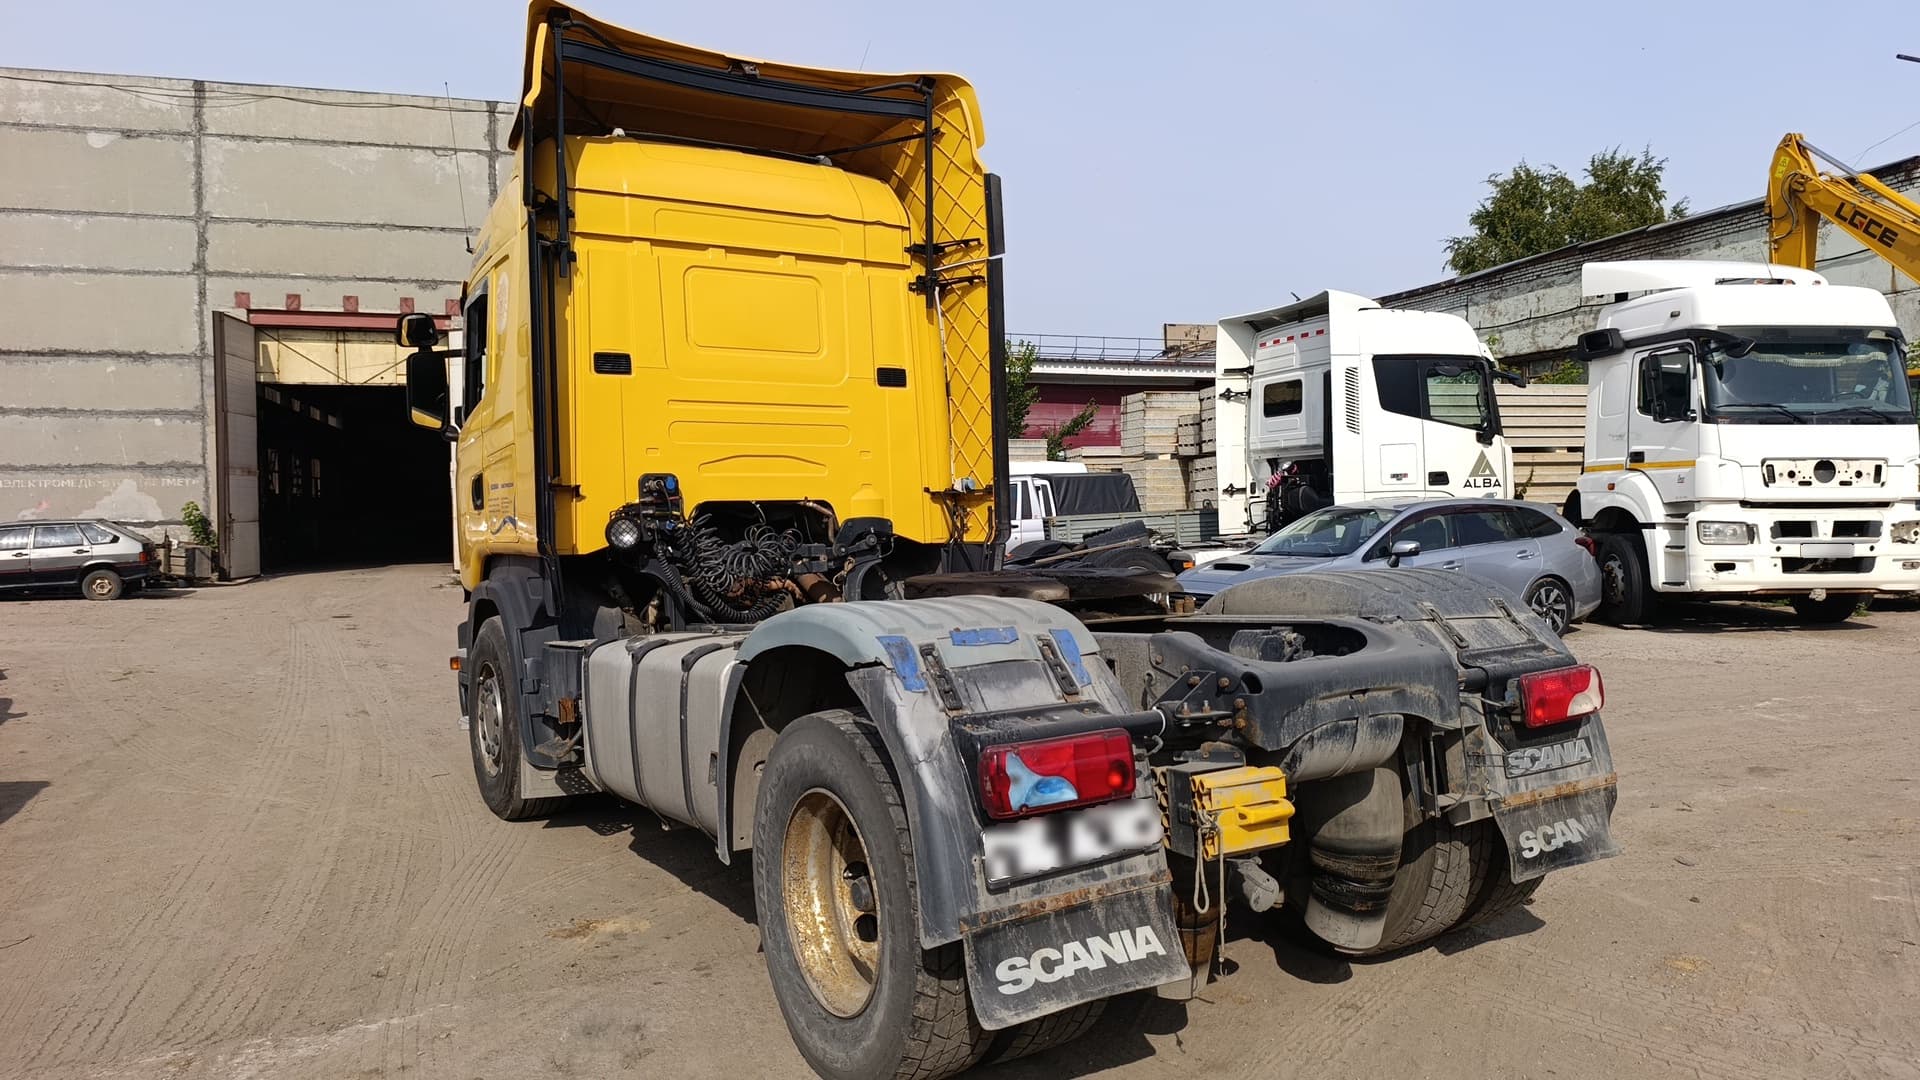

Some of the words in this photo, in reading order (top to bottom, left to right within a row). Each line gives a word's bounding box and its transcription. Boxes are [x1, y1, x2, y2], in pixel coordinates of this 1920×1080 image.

[1463, 478, 1502, 488] ALBA
[1507, 738, 1592, 774] SCANIA
[1518, 815, 1598, 860] SCAN
[995, 925, 1167, 995] SCANIA
